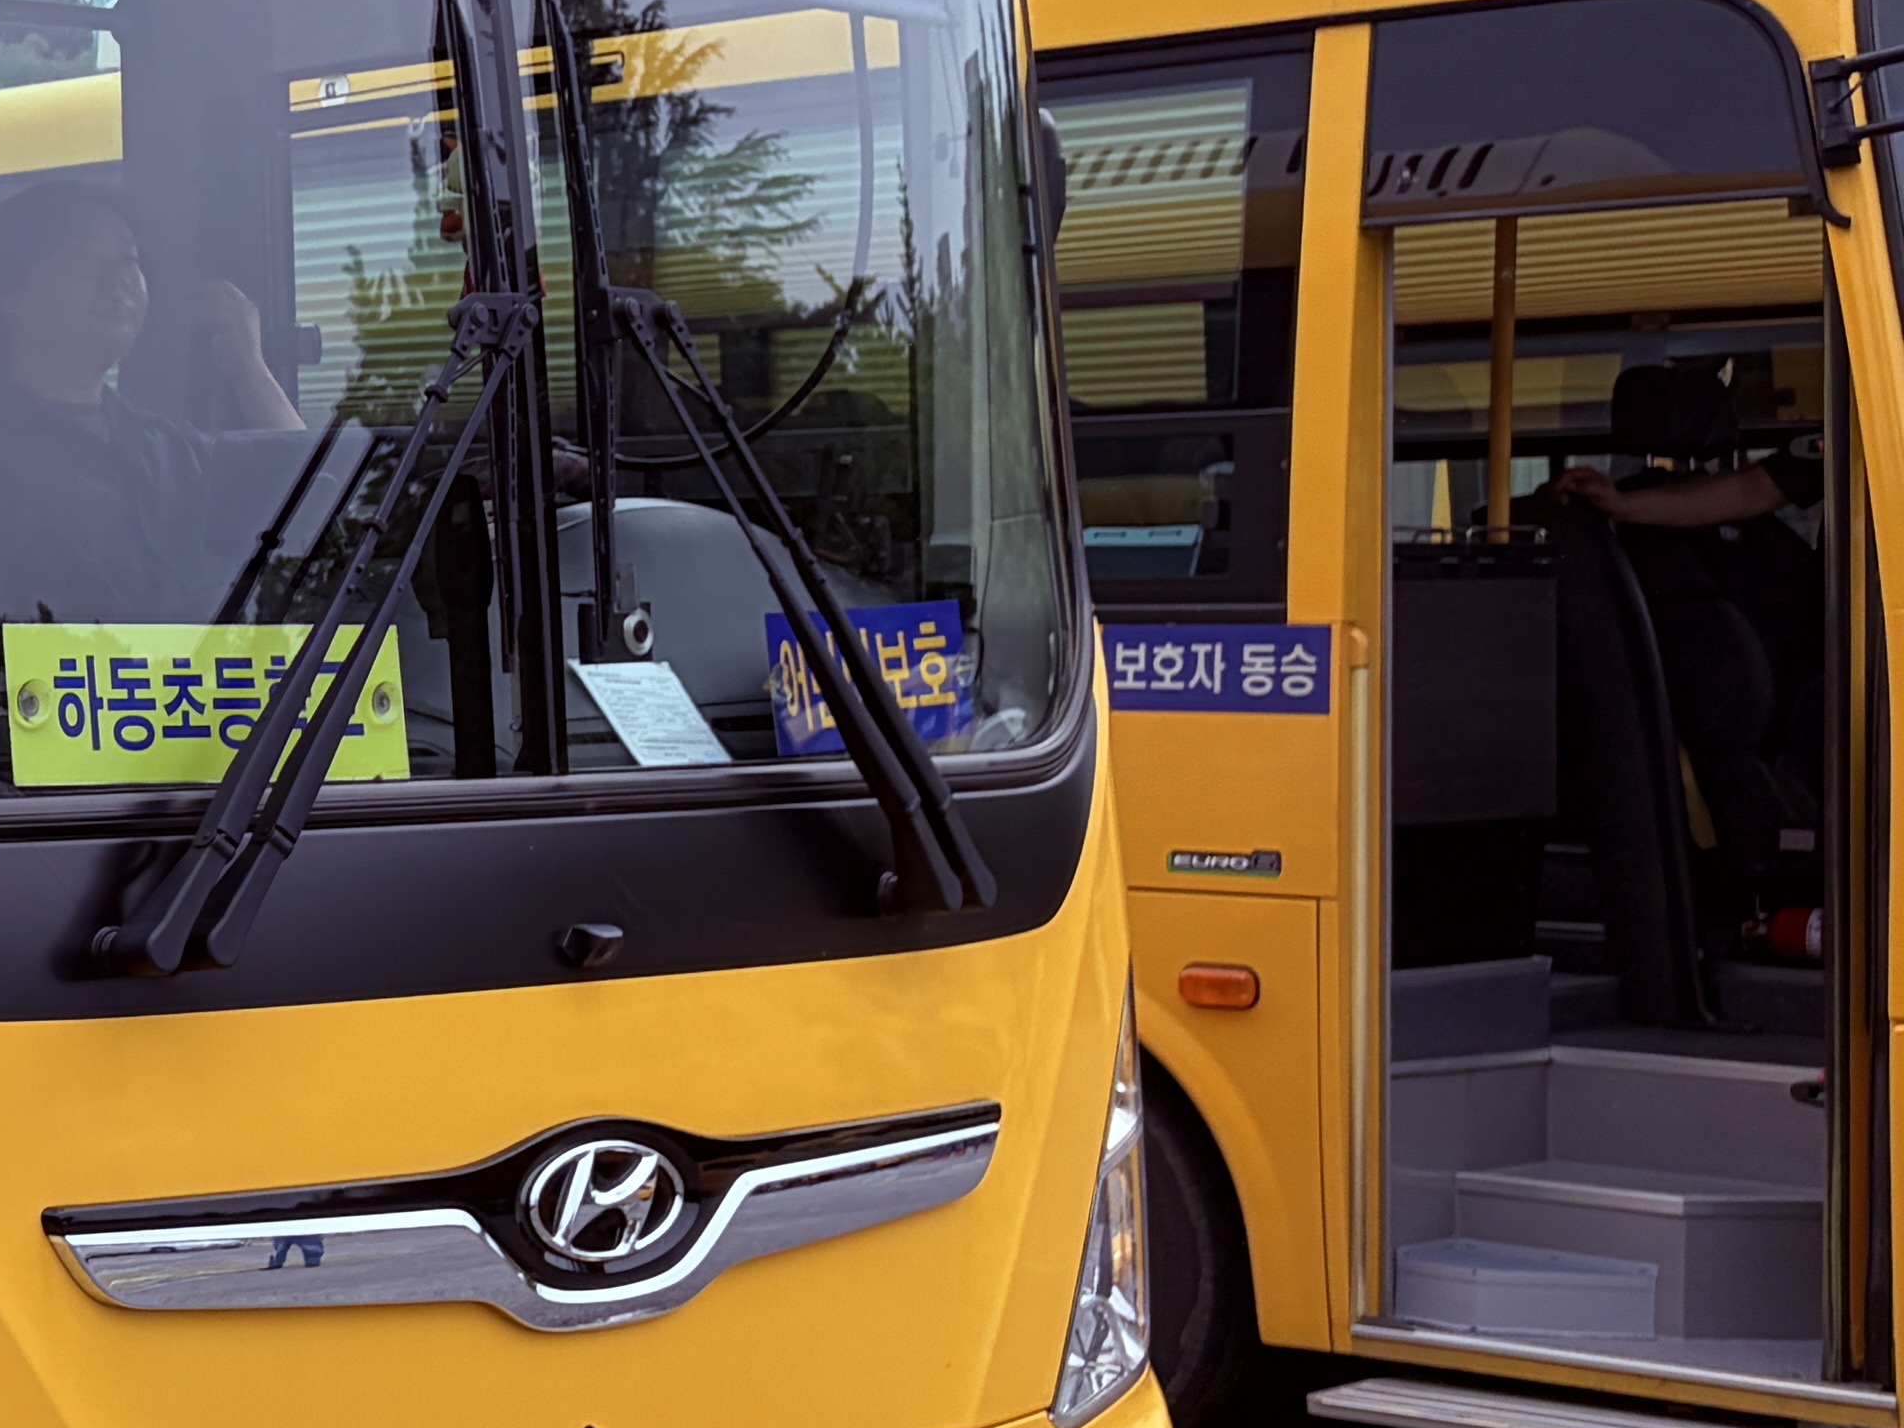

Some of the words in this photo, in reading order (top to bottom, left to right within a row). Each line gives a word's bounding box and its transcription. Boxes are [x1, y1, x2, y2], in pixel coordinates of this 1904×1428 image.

[53, 654, 365, 752] 하동초등
[779, 621, 957, 733] 어보호
[1112, 641, 1226, 695] 보호자
[1239, 642, 1318, 698] 동승
